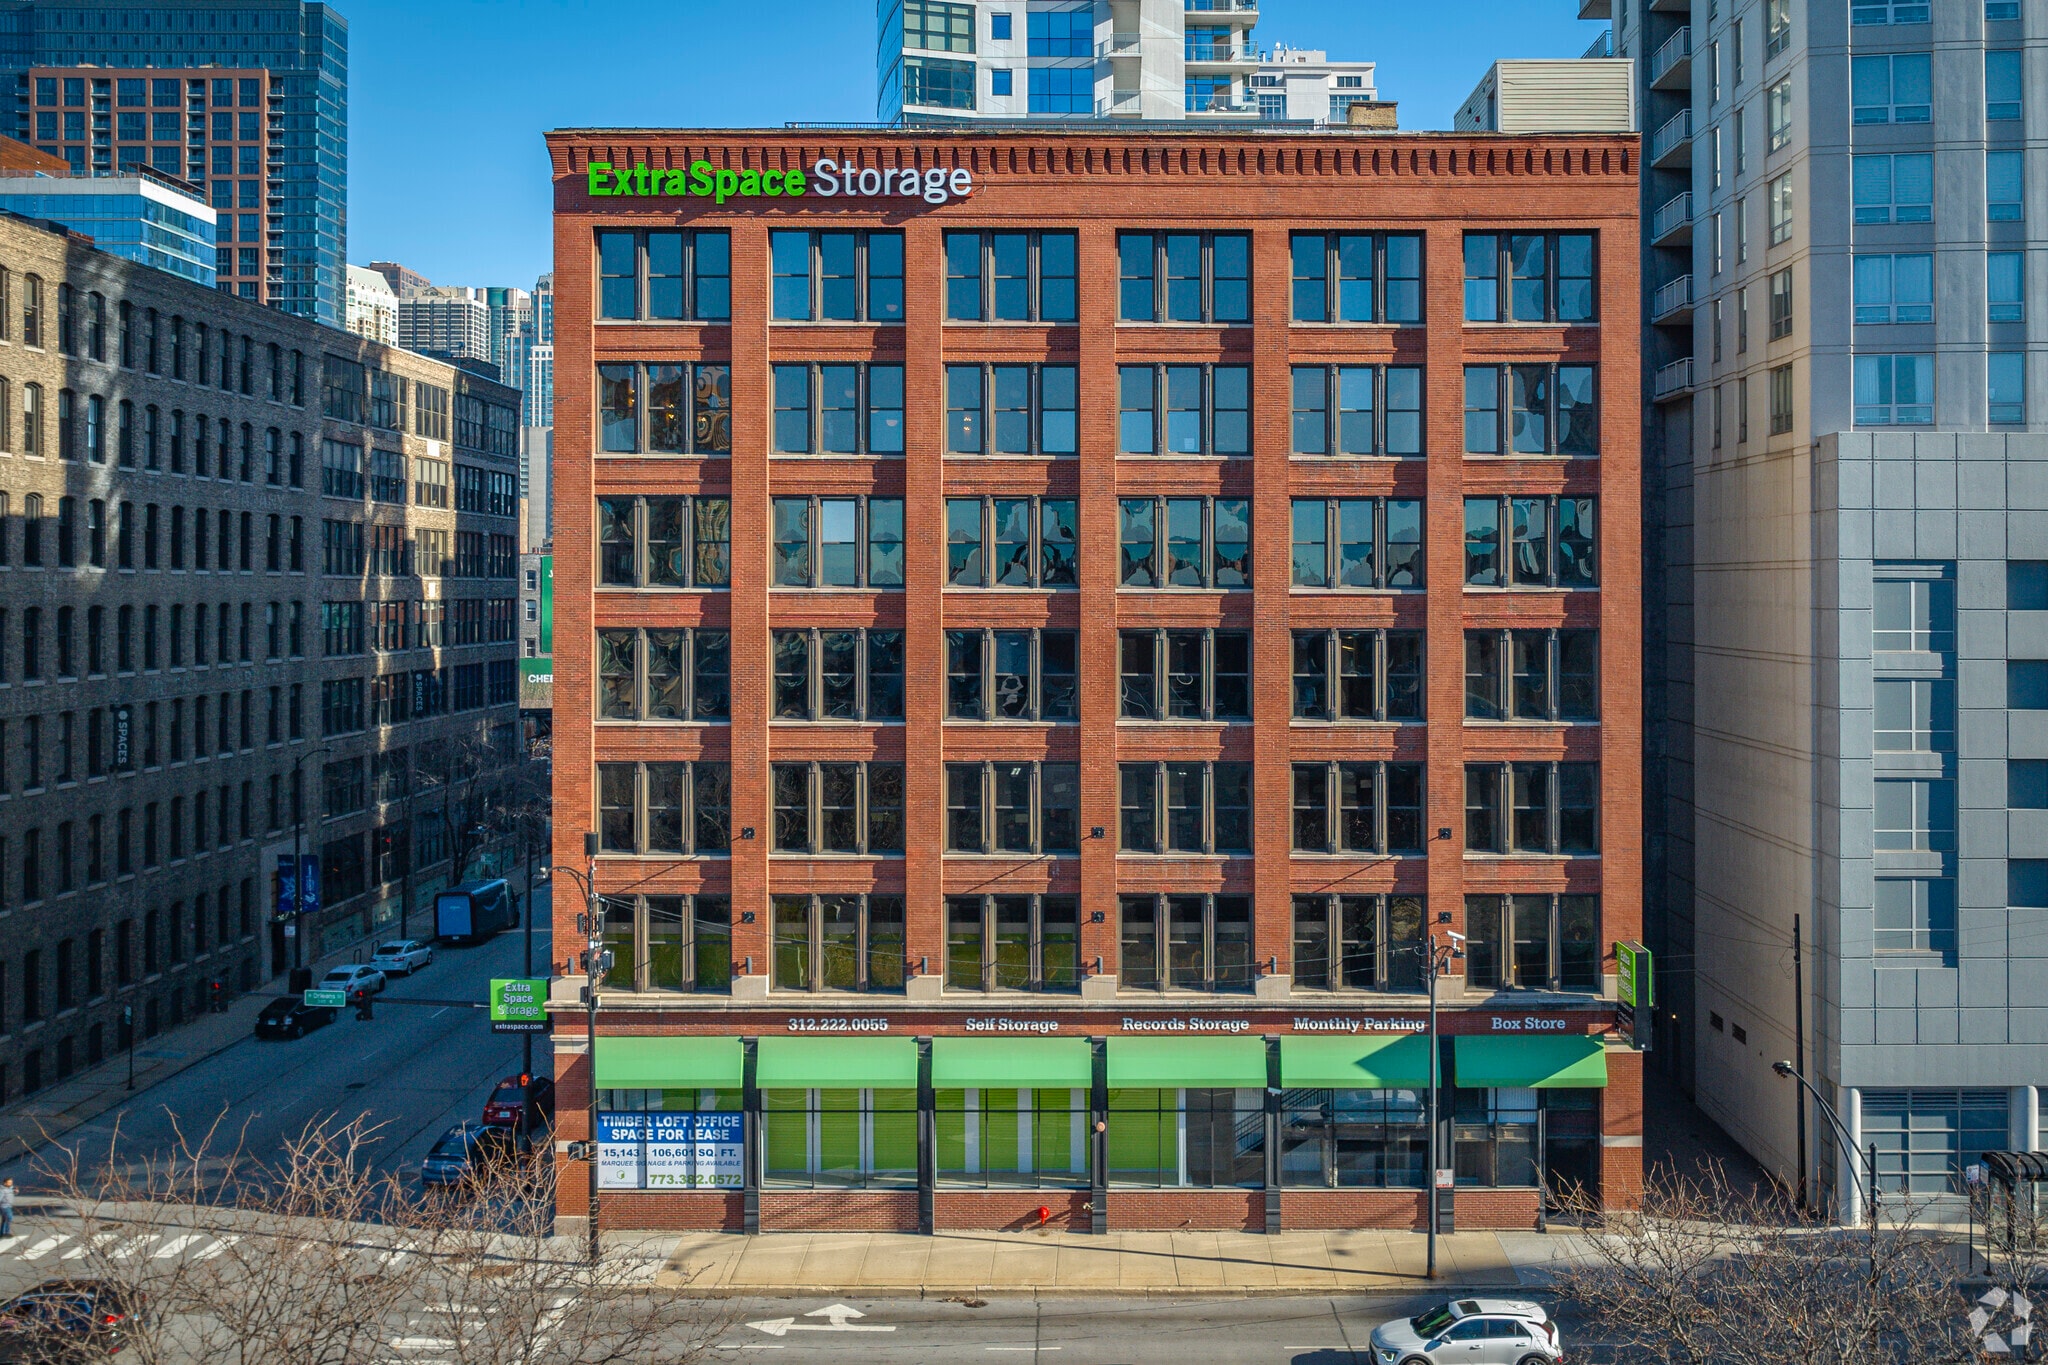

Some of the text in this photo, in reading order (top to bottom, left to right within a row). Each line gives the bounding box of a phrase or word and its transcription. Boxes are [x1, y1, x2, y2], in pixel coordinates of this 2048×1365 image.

[813, 158, 972, 204] Storage
[505, 982, 531, 992] Extra
[503, 993, 533, 1005] Space
[497, 1004, 539, 1017] Storage
[495, 1023, 543, 1031] extraspace.com
[788, 1018, 888, 1031] 312.222.0055
[966, 1018, 1058, 1034] Self Storage
[1122, 1018, 1250, 1032] Records Storage
[1293, 1017, 1425, 1032] Monthly Parking
[1491, 1017, 1566, 1030] Box Store
[601, 1116, 740, 1127] TIMBER LOFT OFFICE
[611, 1129, 729, 1140] SPACE FOR LEASE
[603, 1148, 640, 1158] 15,143
[652, 1148, 694, 1158] 106,601
[698, 1148, 717, 1157] SQ.
[721, 1148, 737, 1157] FT.
[650, 1174, 742, 1185] 773.382.0572
